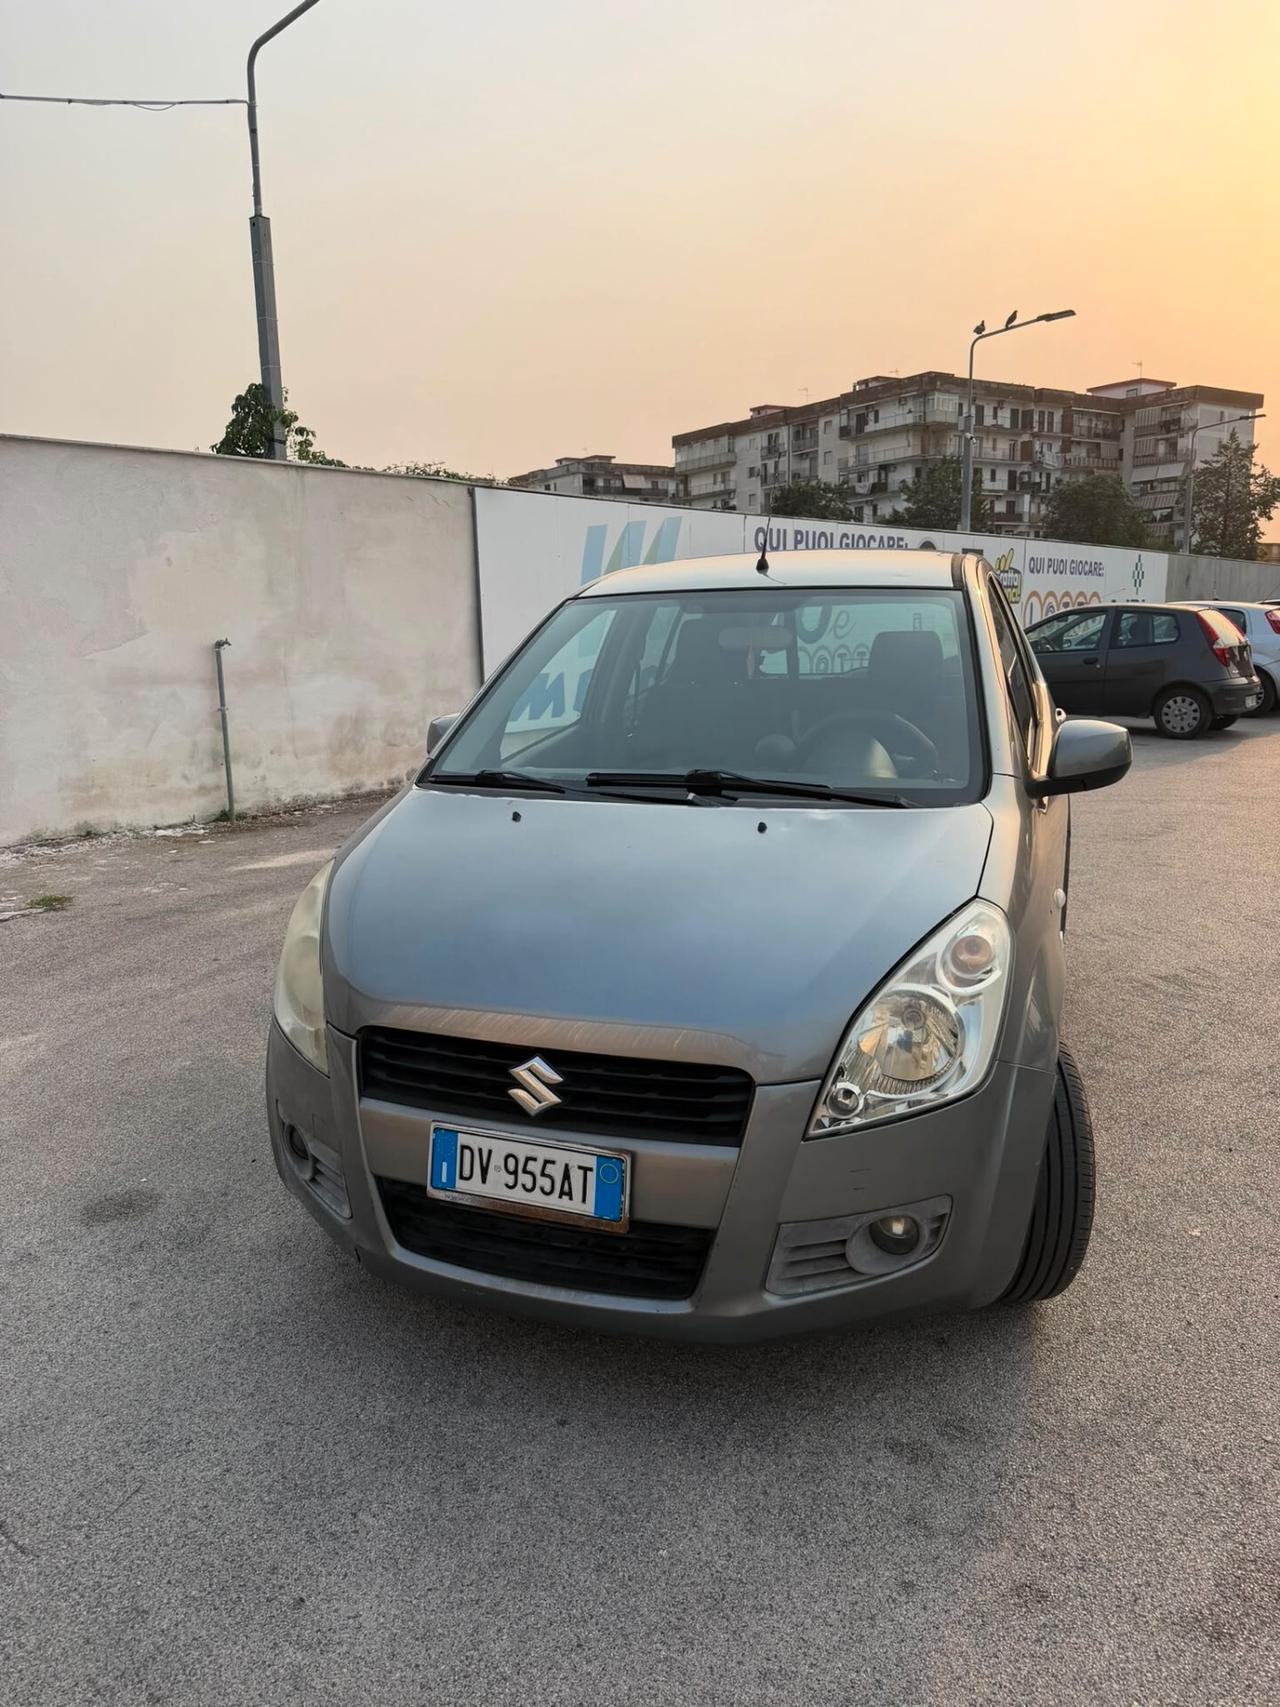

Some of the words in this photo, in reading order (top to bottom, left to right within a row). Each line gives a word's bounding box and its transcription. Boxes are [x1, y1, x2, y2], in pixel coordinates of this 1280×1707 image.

[755, 526, 788, 552] QUI
[794, 529, 834, 550] PUOI
[1029, 556, 1045, 575] QUI
[1047, 557, 1068, 576] PUOI
